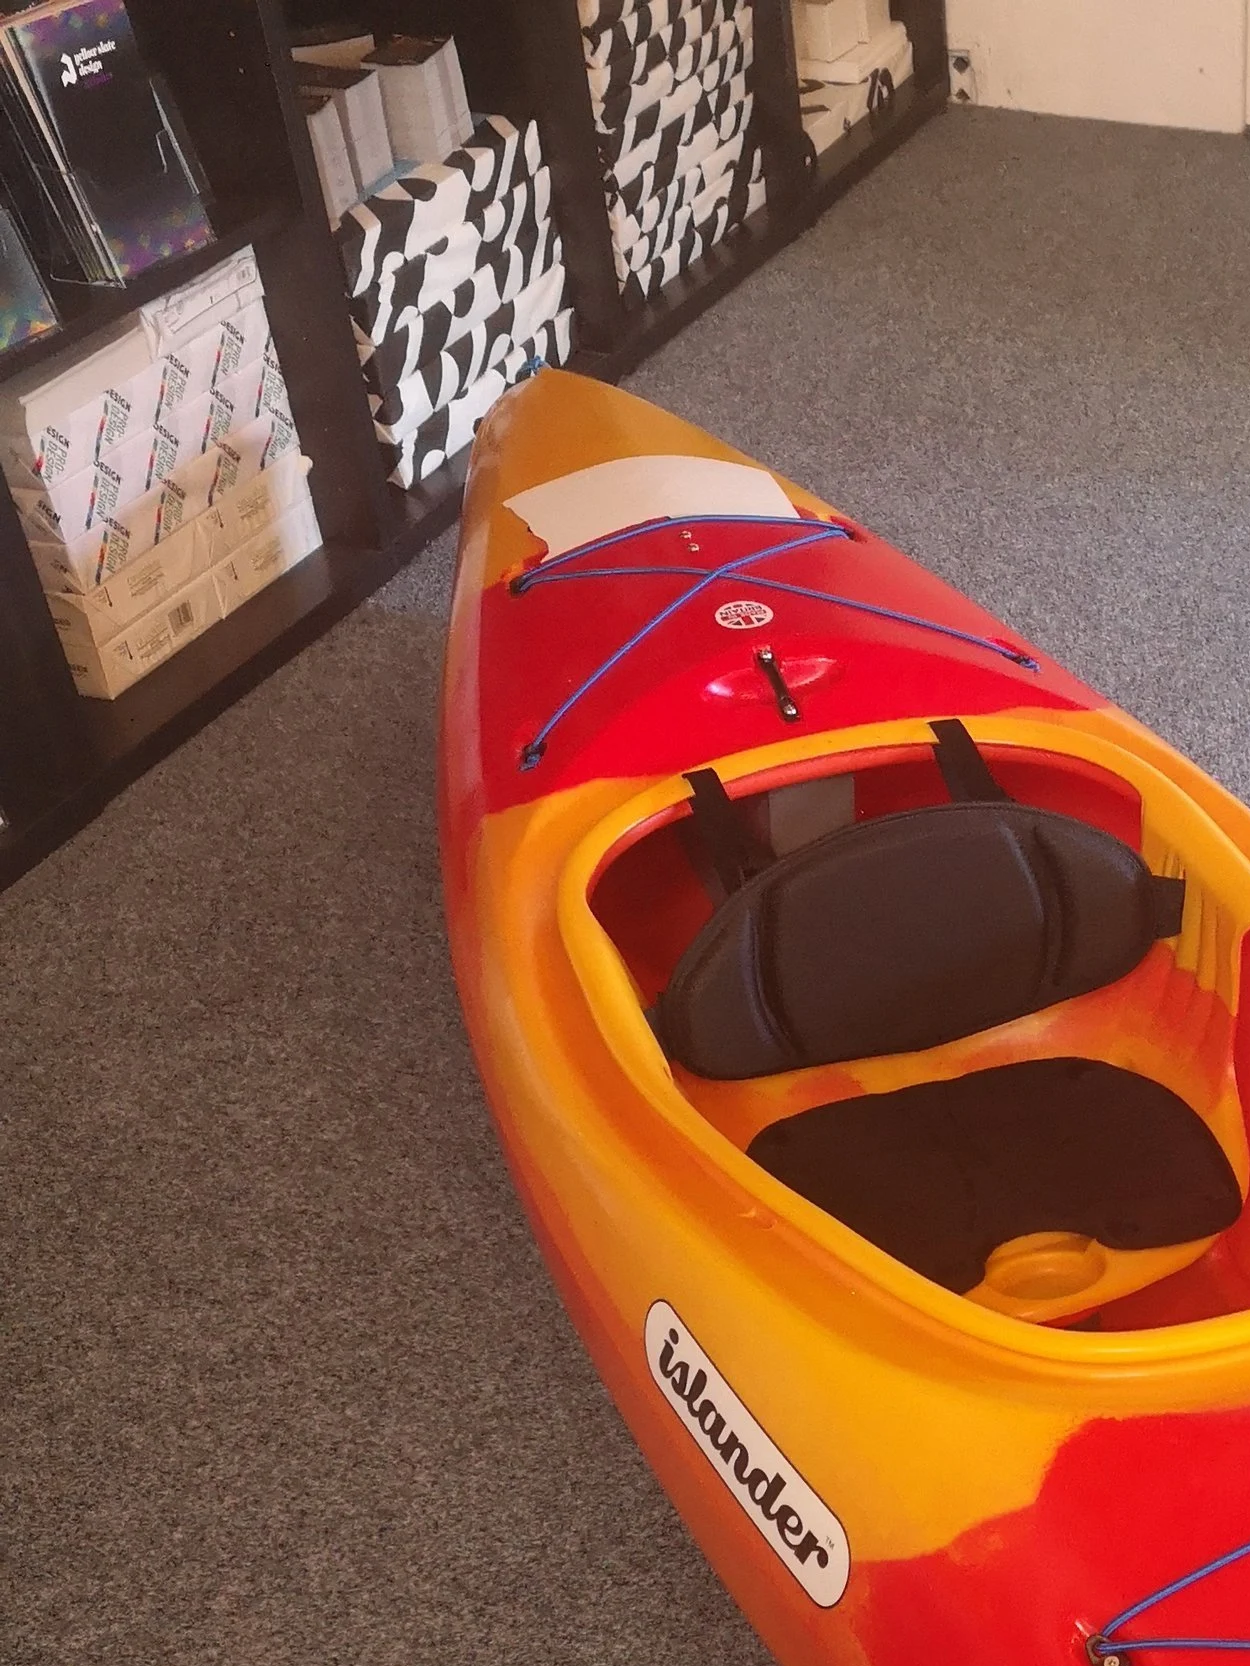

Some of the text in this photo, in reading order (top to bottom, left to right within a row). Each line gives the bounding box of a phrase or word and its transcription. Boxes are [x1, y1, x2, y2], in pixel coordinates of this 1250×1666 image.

[74, 41, 116, 66] yellow slate
[79, 60, 103, 76] design
[43, 440, 58, 483] DESIGN
[55, 447, 68, 475] PRO-
[96, 477, 110, 518] DESIGN
[659, 1328, 829, 1569] islander
